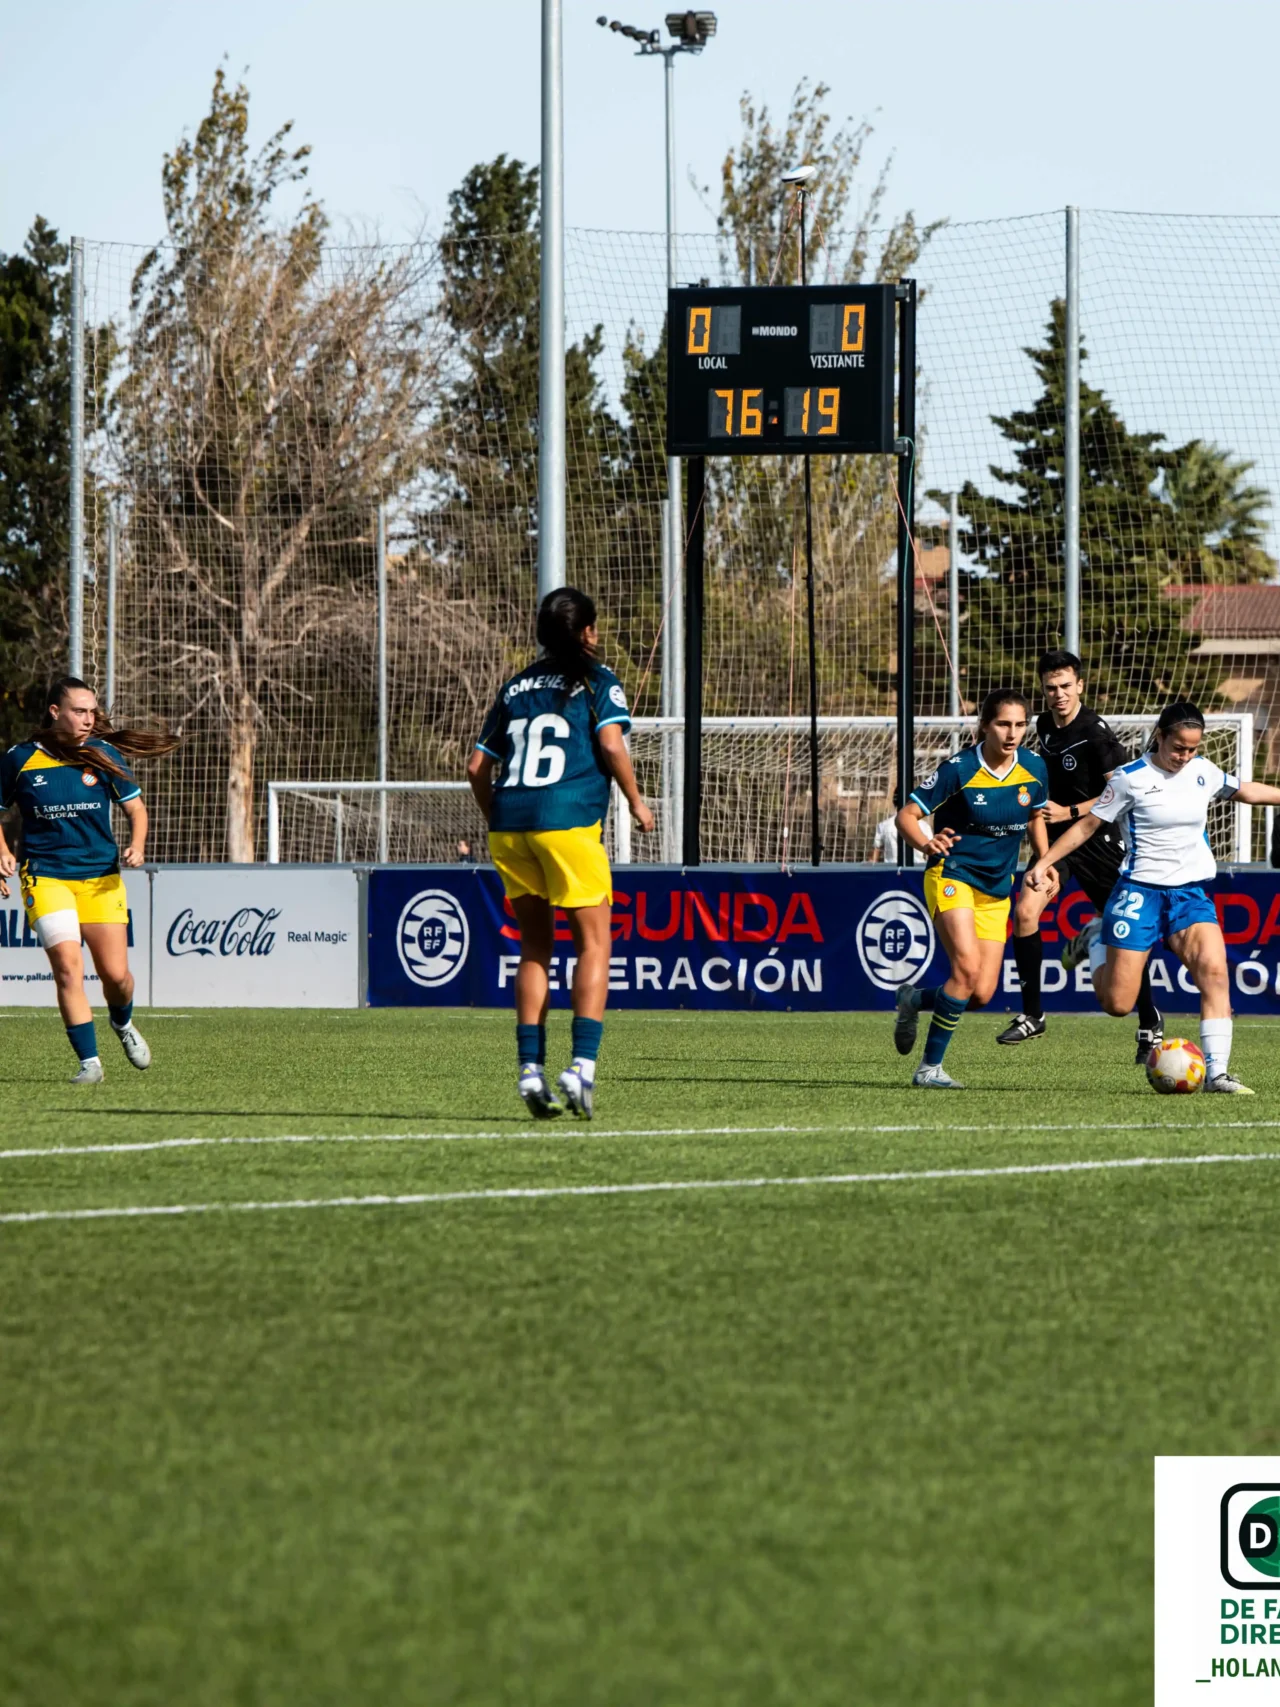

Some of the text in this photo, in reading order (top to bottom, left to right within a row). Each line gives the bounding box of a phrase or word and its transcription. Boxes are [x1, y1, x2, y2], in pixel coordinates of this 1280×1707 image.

[688, 307, 711, 355] 0
[760, 326, 798, 337] MONDO
[841, 303, 866, 352] 0
[698, 356, 728, 370] LOCAL
[810, 354, 865, 369] VISITANTE
[503, 712, 570, 788] 16
[66, 801, 102, 812] JURÍDICA
[1111, 889, 1145, 921] 22
[287, 931, 312, 943] Real
[314, 930, 348, 945] Magic
[423, 926, 443, 938] RF
[886, 928, 907, 941] RF
[424, 939, 441, 950] EF
[885, 941, 905, 954] EF
